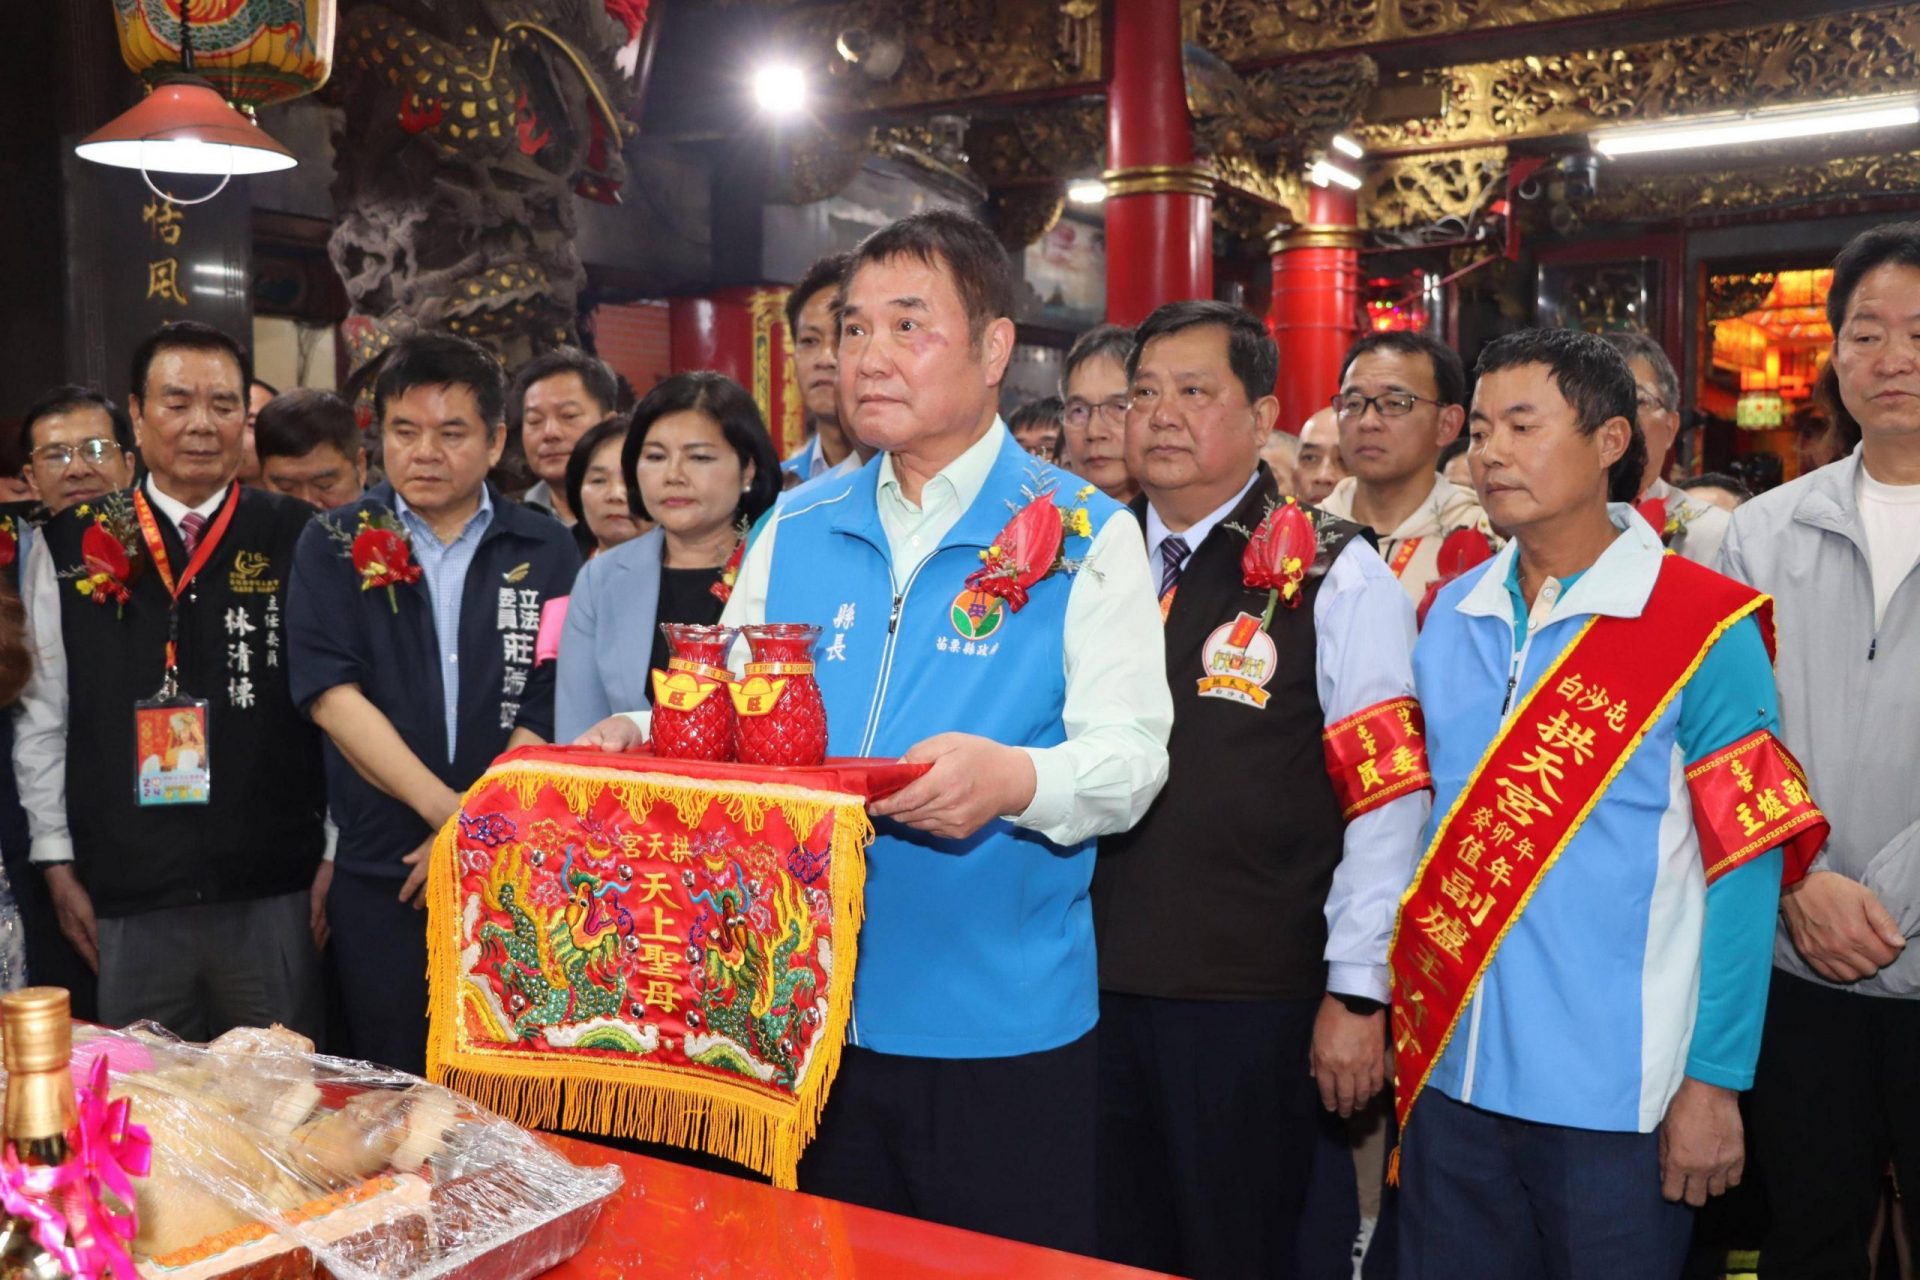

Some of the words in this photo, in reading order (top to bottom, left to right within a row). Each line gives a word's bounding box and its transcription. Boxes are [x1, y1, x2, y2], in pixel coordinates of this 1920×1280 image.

[264, 594, 280, 668] 主任委員
[497, 586, 518, 631] 委員
[519, 588, 540, 631] 立法
[826, 602, 856, 662] 縣長
[668, 691, 687, 707] 旺
[746, 695, 763, 713] 旺
[1556, 673, 1628, 733] 白沙屯
[1496, 709, 1597, 828] 拱天宮
[1456, 834, 1514, 888] 值年
[1468, 806, 1536, 862] 癸卯年
[639, 872, 683, 1014] 天上聖母
